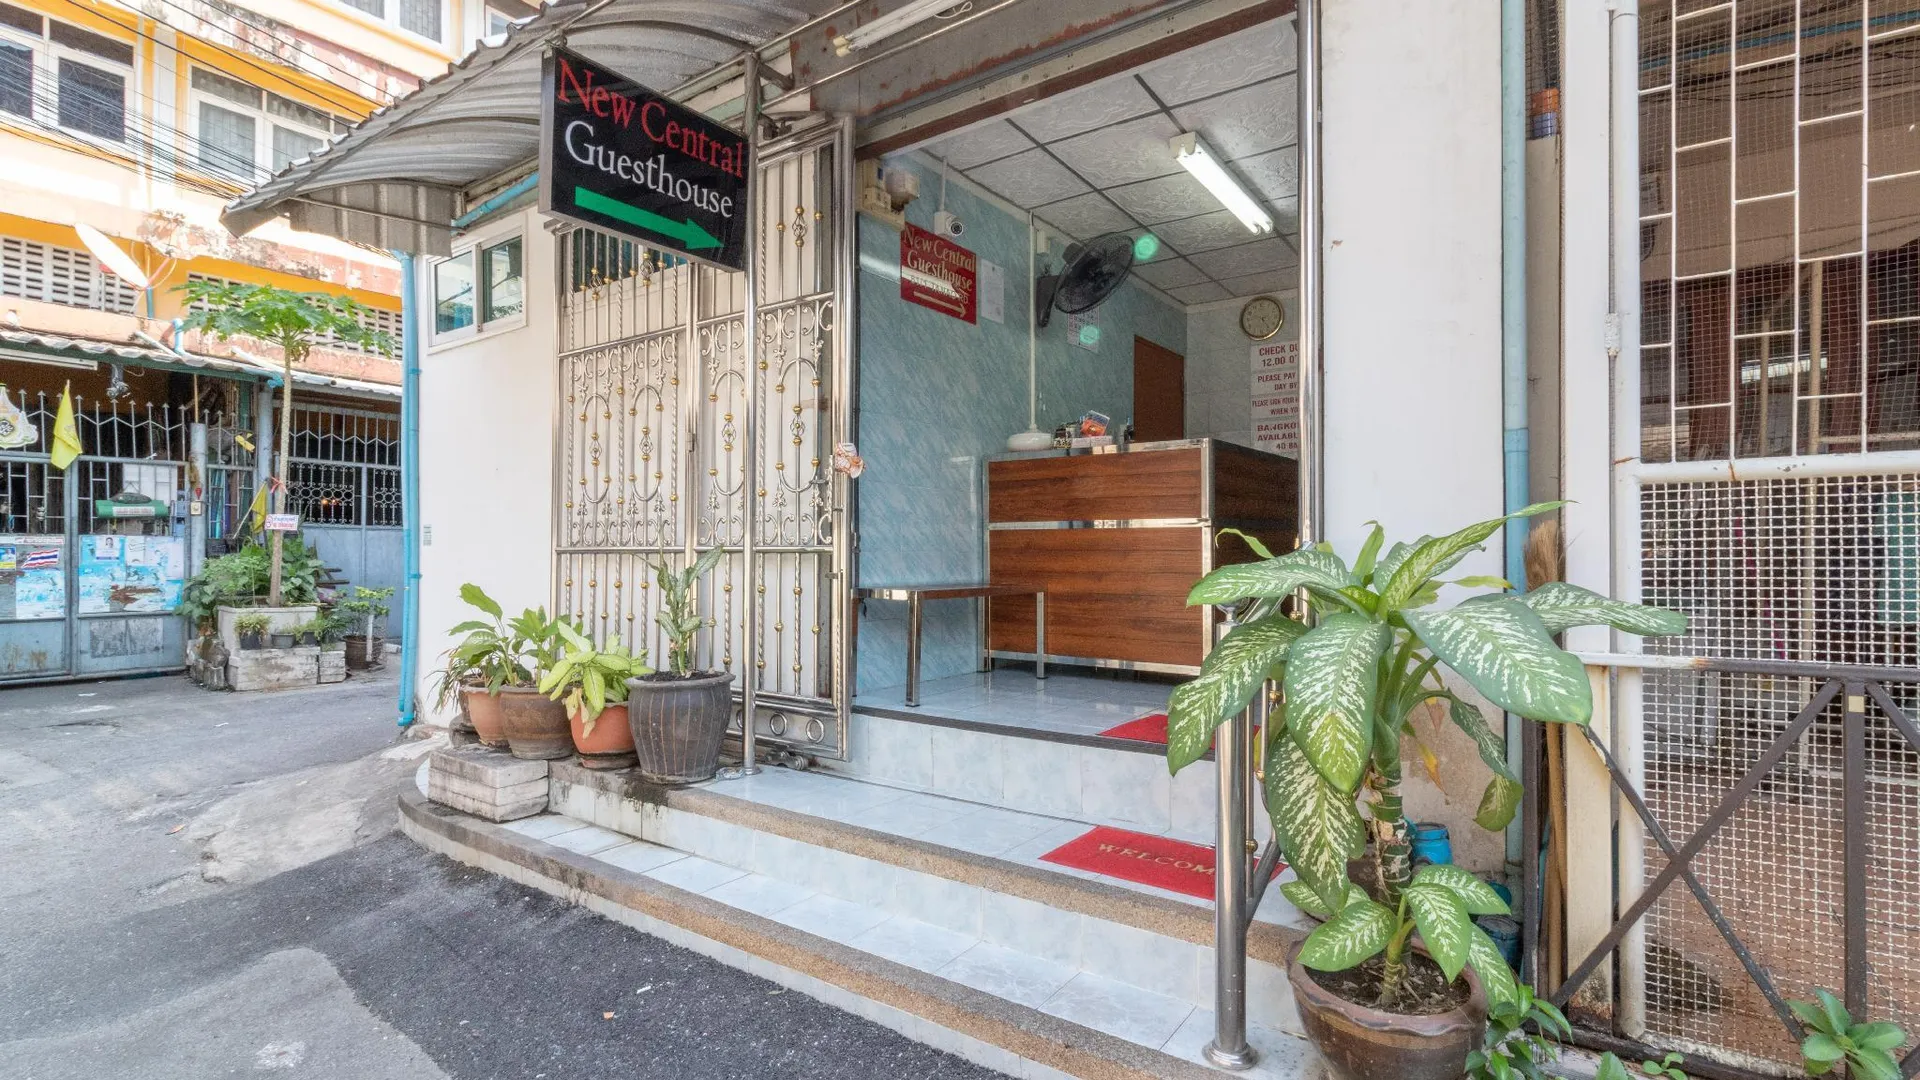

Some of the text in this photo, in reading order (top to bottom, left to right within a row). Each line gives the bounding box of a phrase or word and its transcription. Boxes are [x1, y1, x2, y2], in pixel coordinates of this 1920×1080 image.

[558, 57, 743, 178] New Central
[565, 120, 733, 217] Guesthouse
[904, 226, 976, 273] New Central
[907, 250, 973, 291] Guesthouse
[1259, 345, 1286, 356] CHECK
[1262, 357, 1286, 367] 12.00
[1257, 374, 1282, 383] PLEASE
[1252, 400, 1269, 408] PLEASE
[1257, 422, 1299, 431] BANGKO
